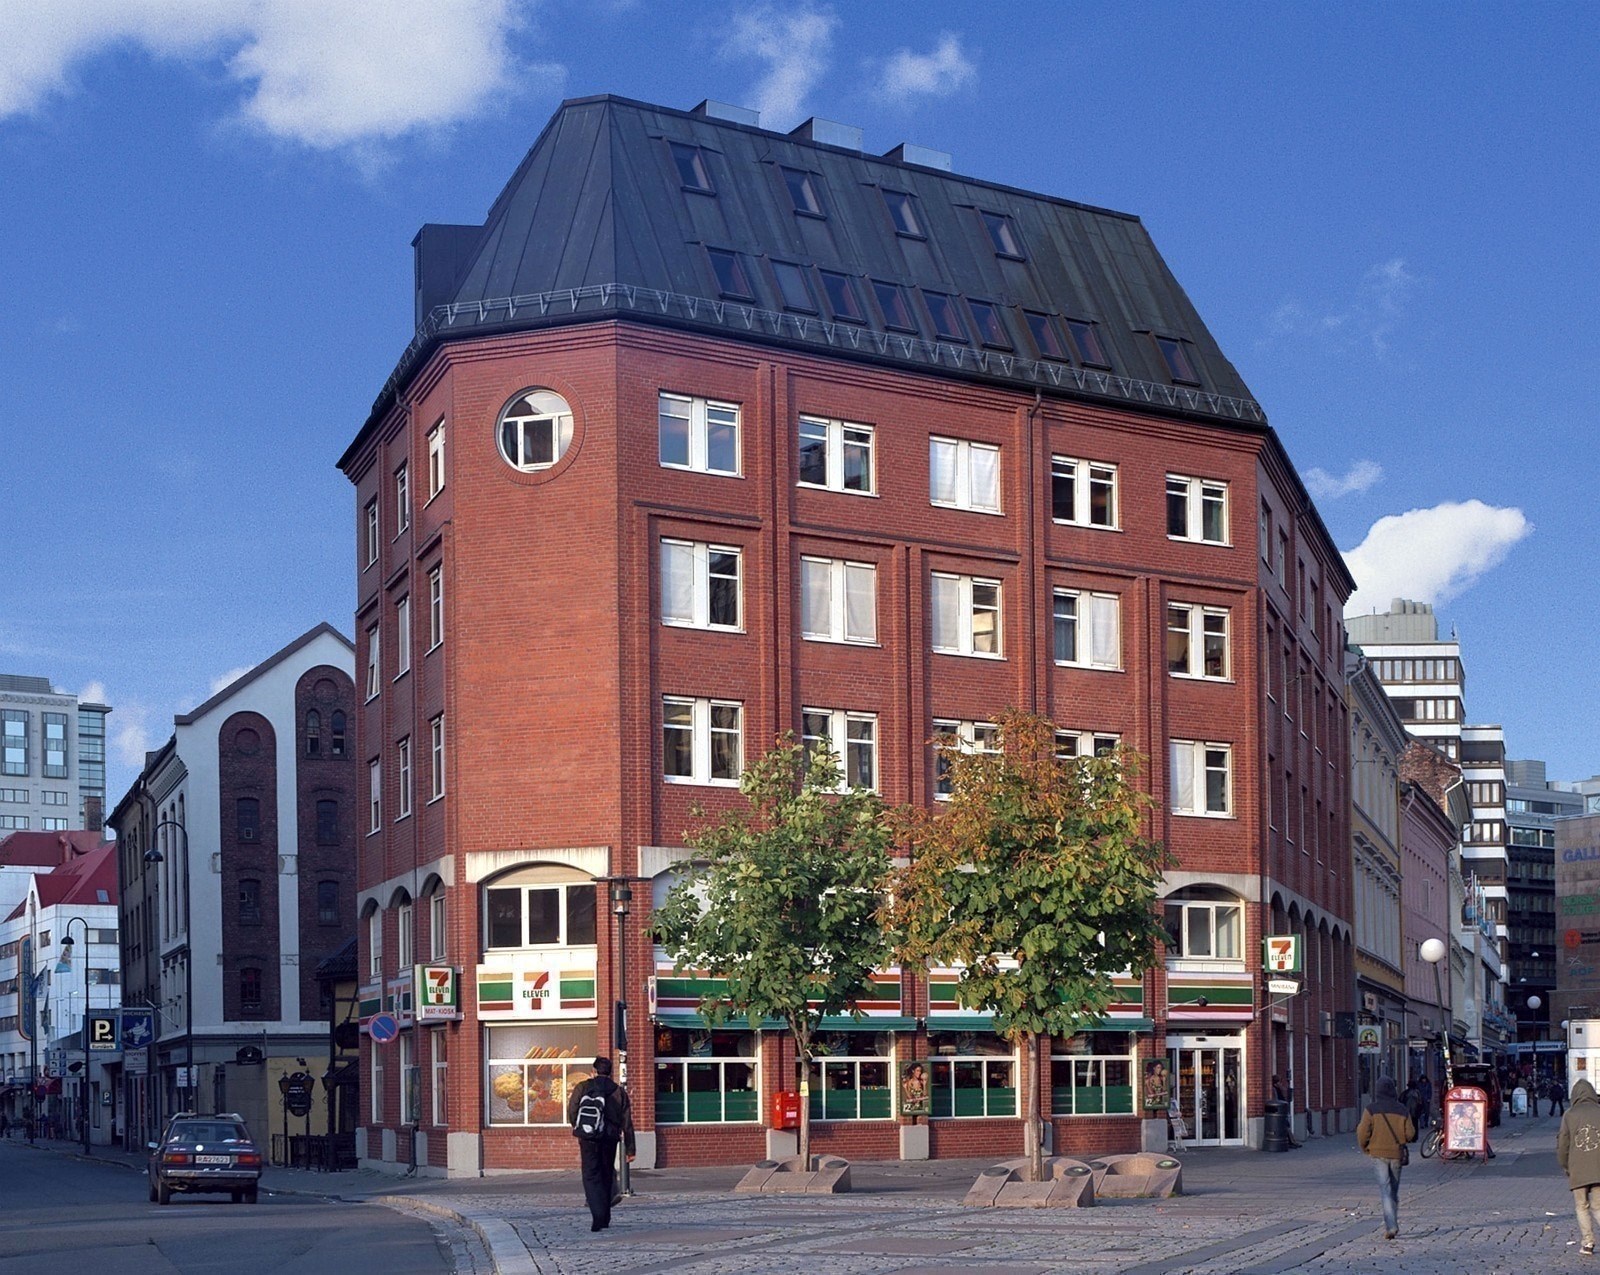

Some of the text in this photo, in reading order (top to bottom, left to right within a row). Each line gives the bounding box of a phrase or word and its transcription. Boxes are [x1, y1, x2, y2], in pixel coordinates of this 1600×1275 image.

[1271, 940, 1291, 969] 7
[429, 971, 449, 1003] 7
[429, 986, 450, 994] ELEVEN
[522, 990, 550, 998] ELEVEN
[524, 971, 549, 1010] 7
[95, 1020, 110, 1041] P
